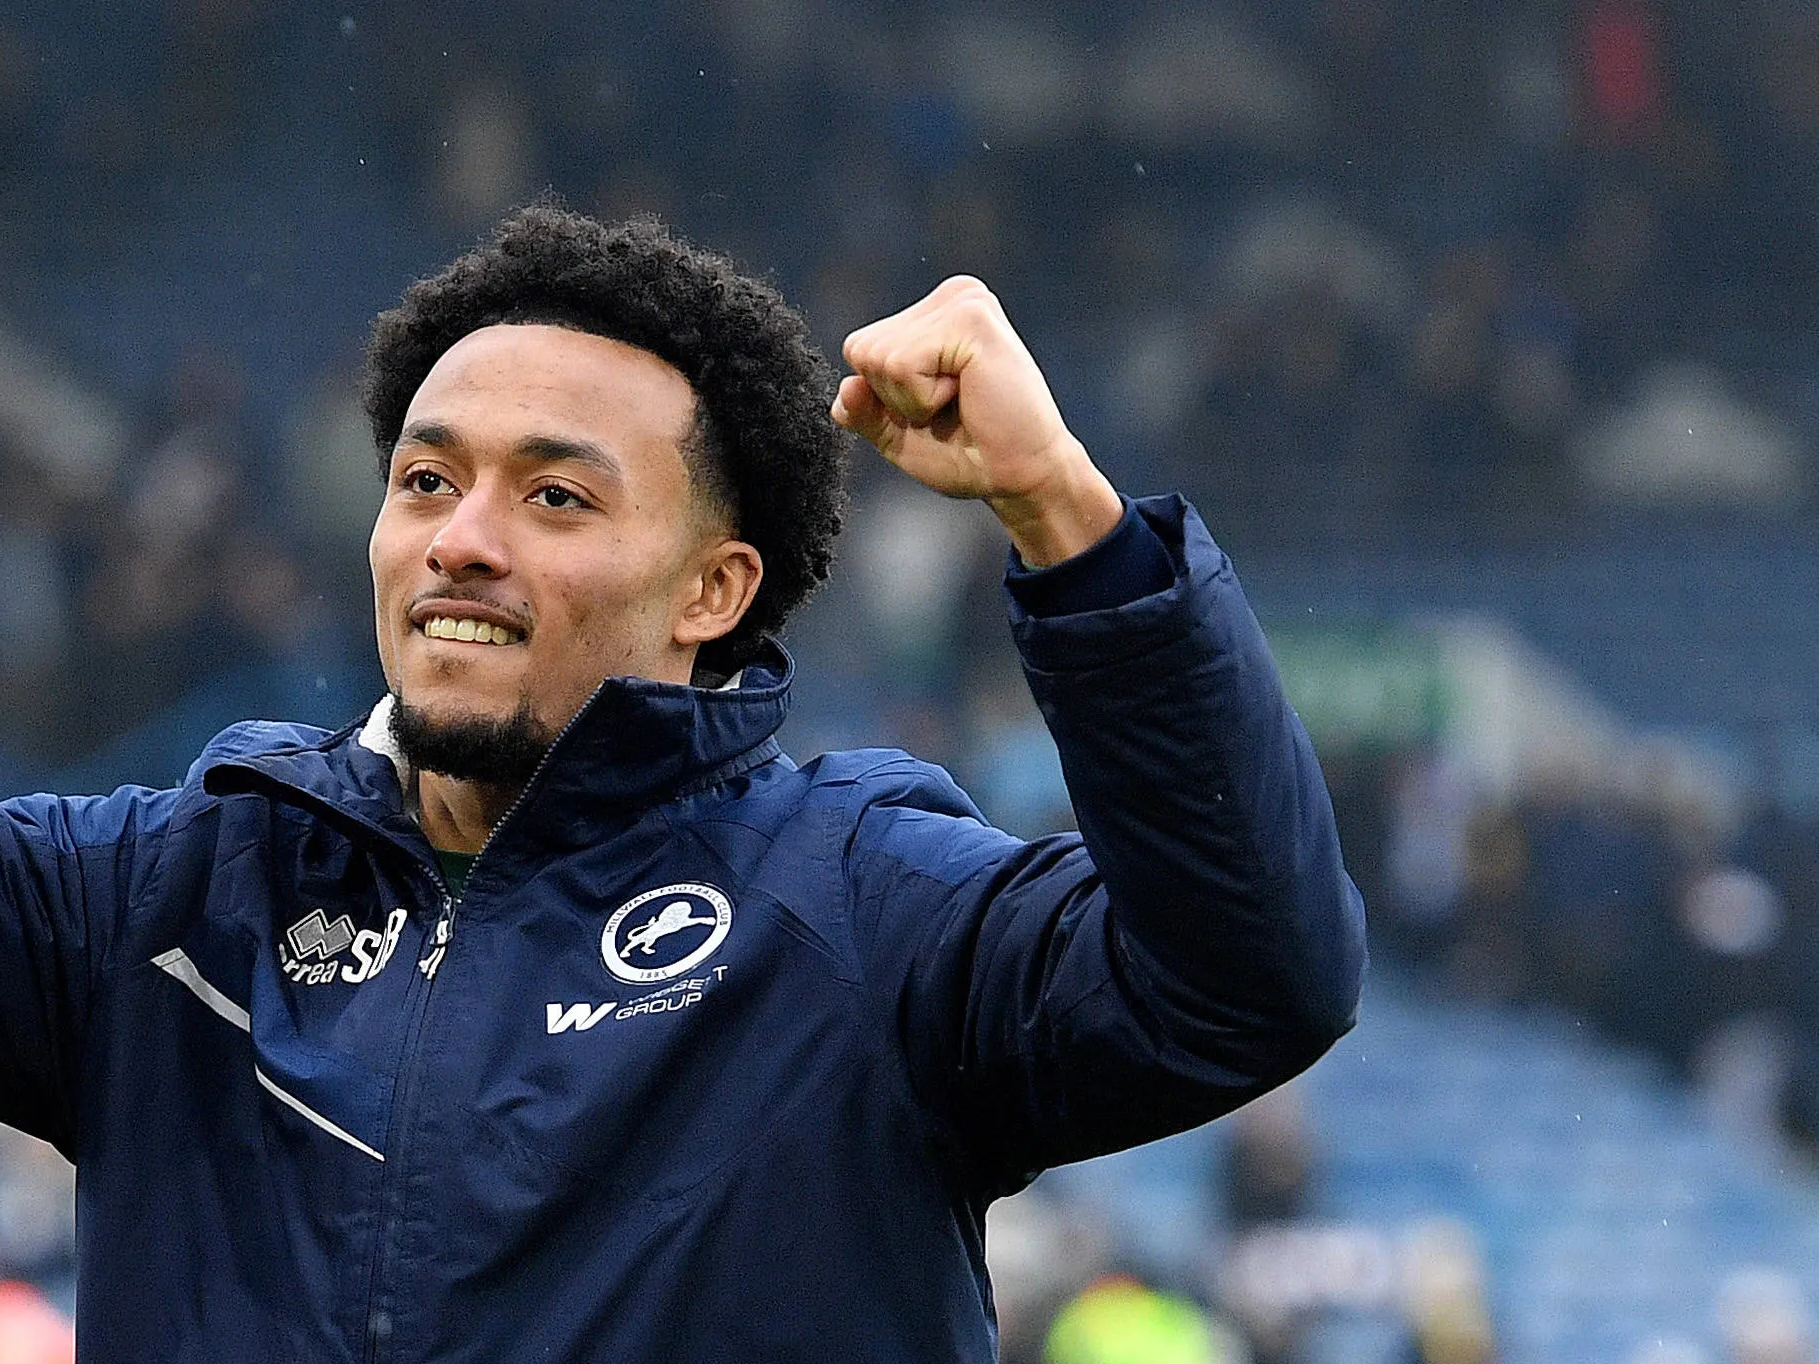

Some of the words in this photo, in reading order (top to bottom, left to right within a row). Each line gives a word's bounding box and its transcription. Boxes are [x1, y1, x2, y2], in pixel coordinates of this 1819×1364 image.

[716, 901, 729, 926] CLUB
[341, 908, 408, 983] SB
[615, 992, 703, 1020] GROUP
